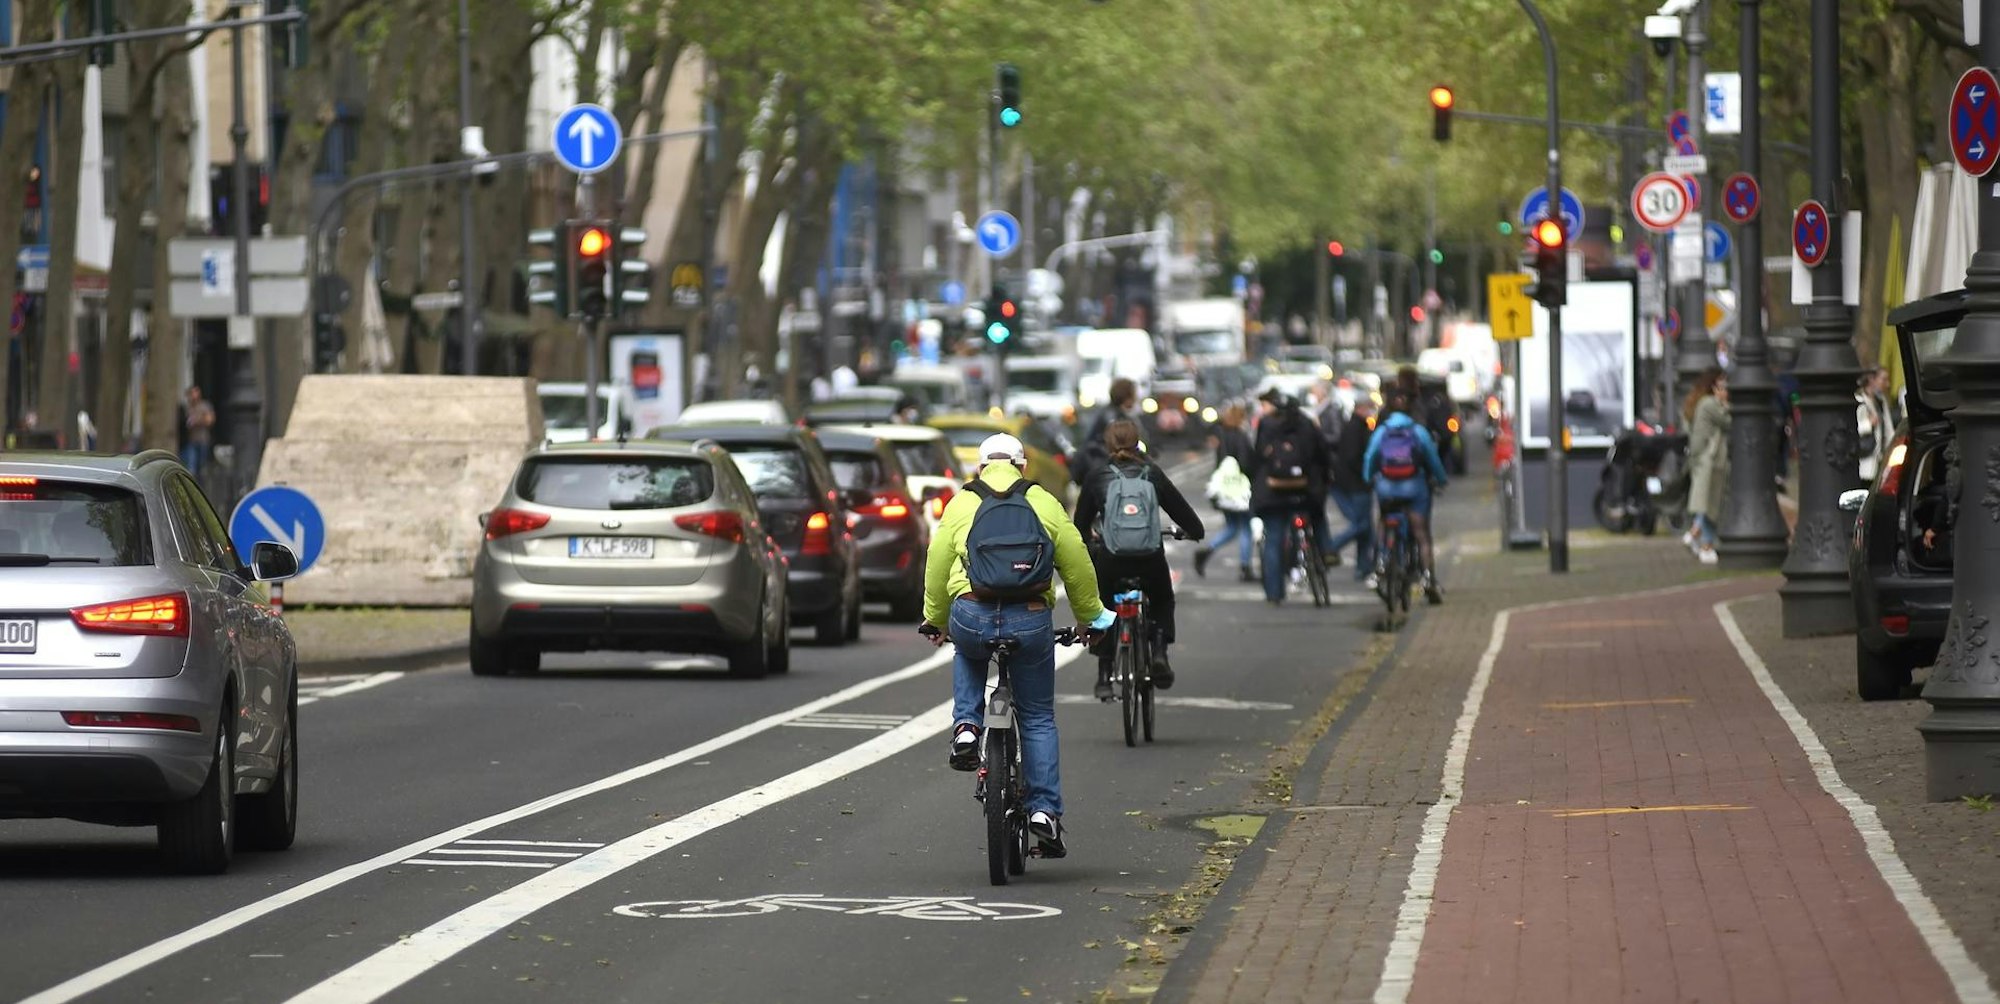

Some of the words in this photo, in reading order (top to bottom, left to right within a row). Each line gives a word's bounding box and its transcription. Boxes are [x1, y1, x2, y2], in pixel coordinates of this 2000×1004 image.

[1645, 188, 1678, 214] 30
[582, 538, 592, 552] K
[622, 538, 648, 553] 598
